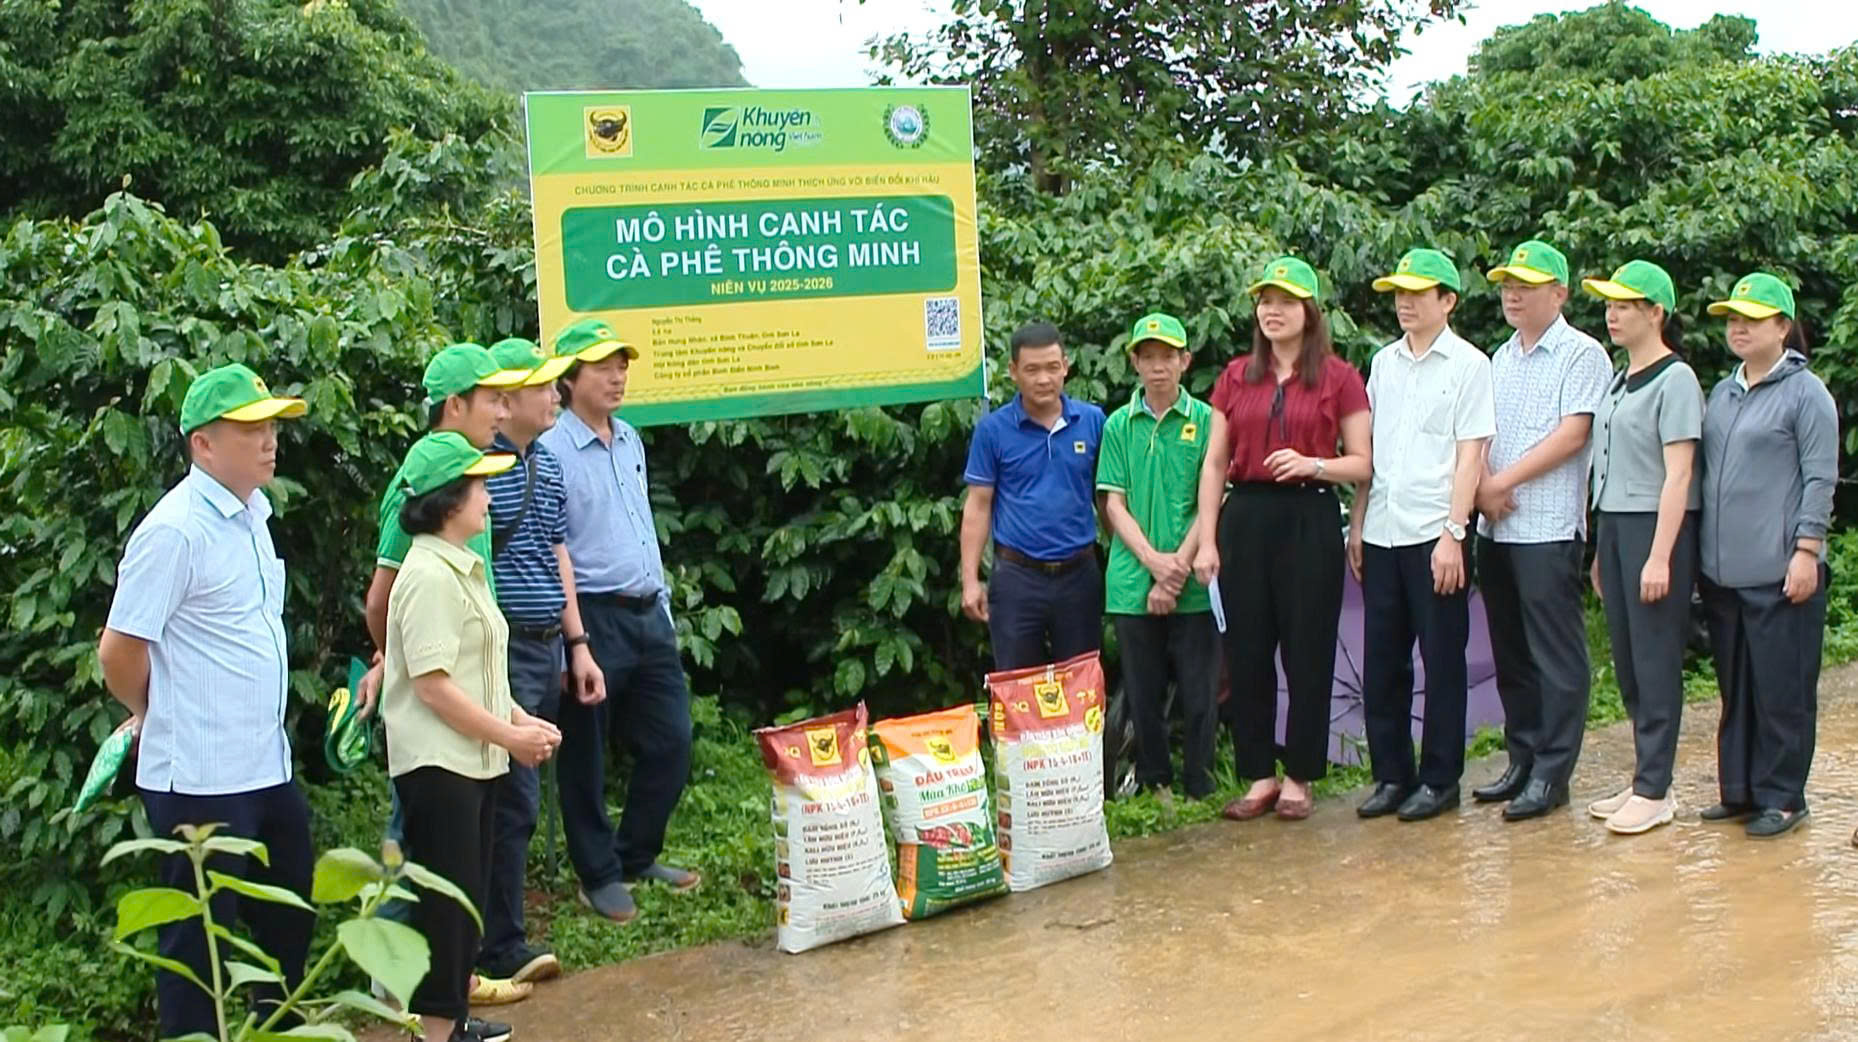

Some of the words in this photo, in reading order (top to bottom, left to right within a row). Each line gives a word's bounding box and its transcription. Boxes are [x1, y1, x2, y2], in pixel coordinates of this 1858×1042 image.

[616, 211, 665, 243] MÔ
[675, 209, 748, 240] HÌNH
[759, 210, 841, 237] CANH
[851, 203, 908, 232] TÁC
[606, 247, 651, 279] CÀ
[661, 244, 723, 276] PHÊ
[732, 240, 838, 272] THÔNG
[849, 241, 920, 267] MINH
[711, 279, 744, 295] NIÊN
[748, 280, 766, 294] VỤ
[770, 277, 833, 292] 2025-2026
